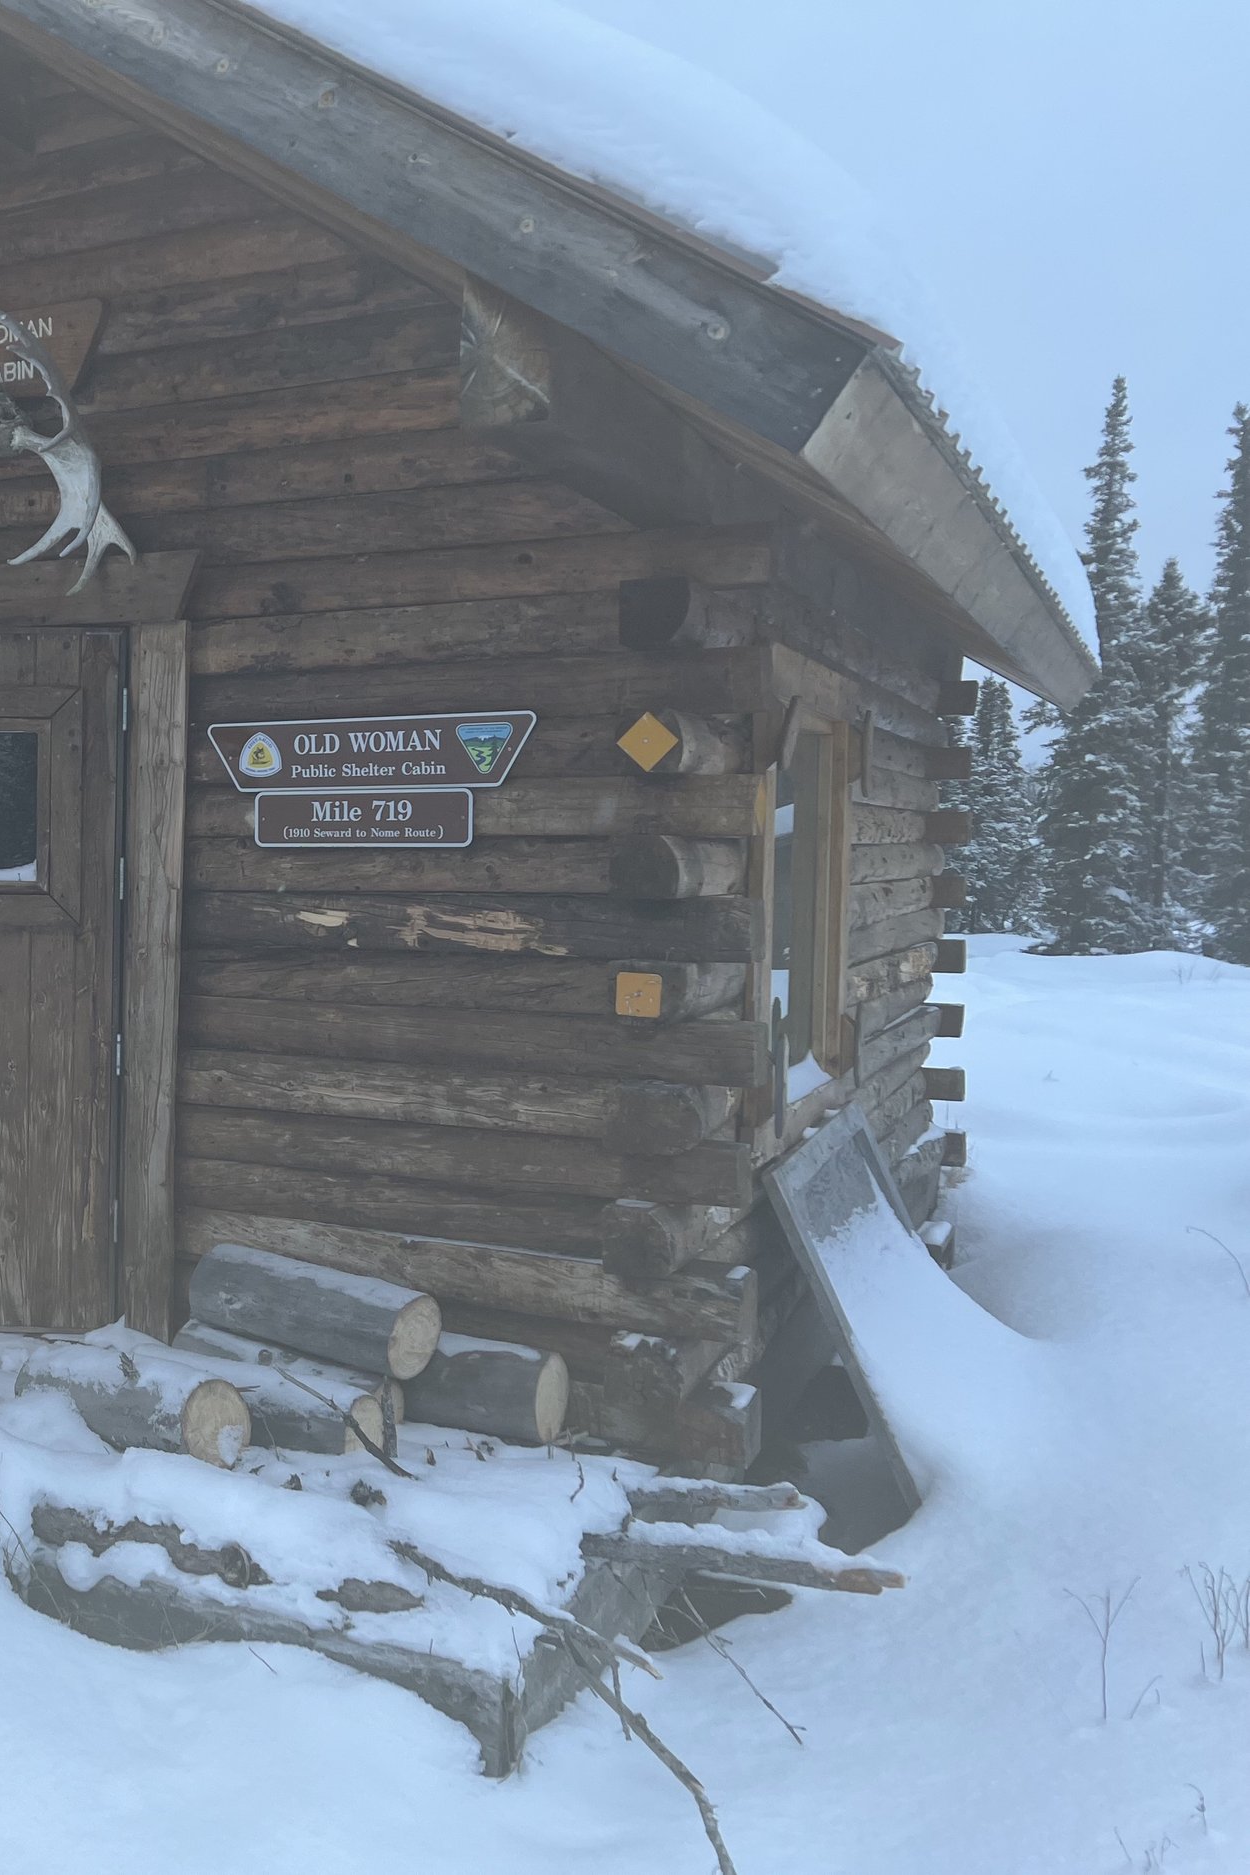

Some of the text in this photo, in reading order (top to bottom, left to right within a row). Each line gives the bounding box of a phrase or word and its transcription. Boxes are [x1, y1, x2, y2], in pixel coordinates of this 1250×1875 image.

[293, 729, 442, 755] OLD WOMAN
[291, 764, 336, 778] Public
[343, 763, 396, 777] Shelter
[401, 761, 446, 775] Cabin
[310, 799, 413, 822] Mile 719
[283, 825, 310, 840] (1910
[313, 827, 352, 838] Seward
[356, 827, 367, 838] to
[370, 827, 401, 838] Nome
